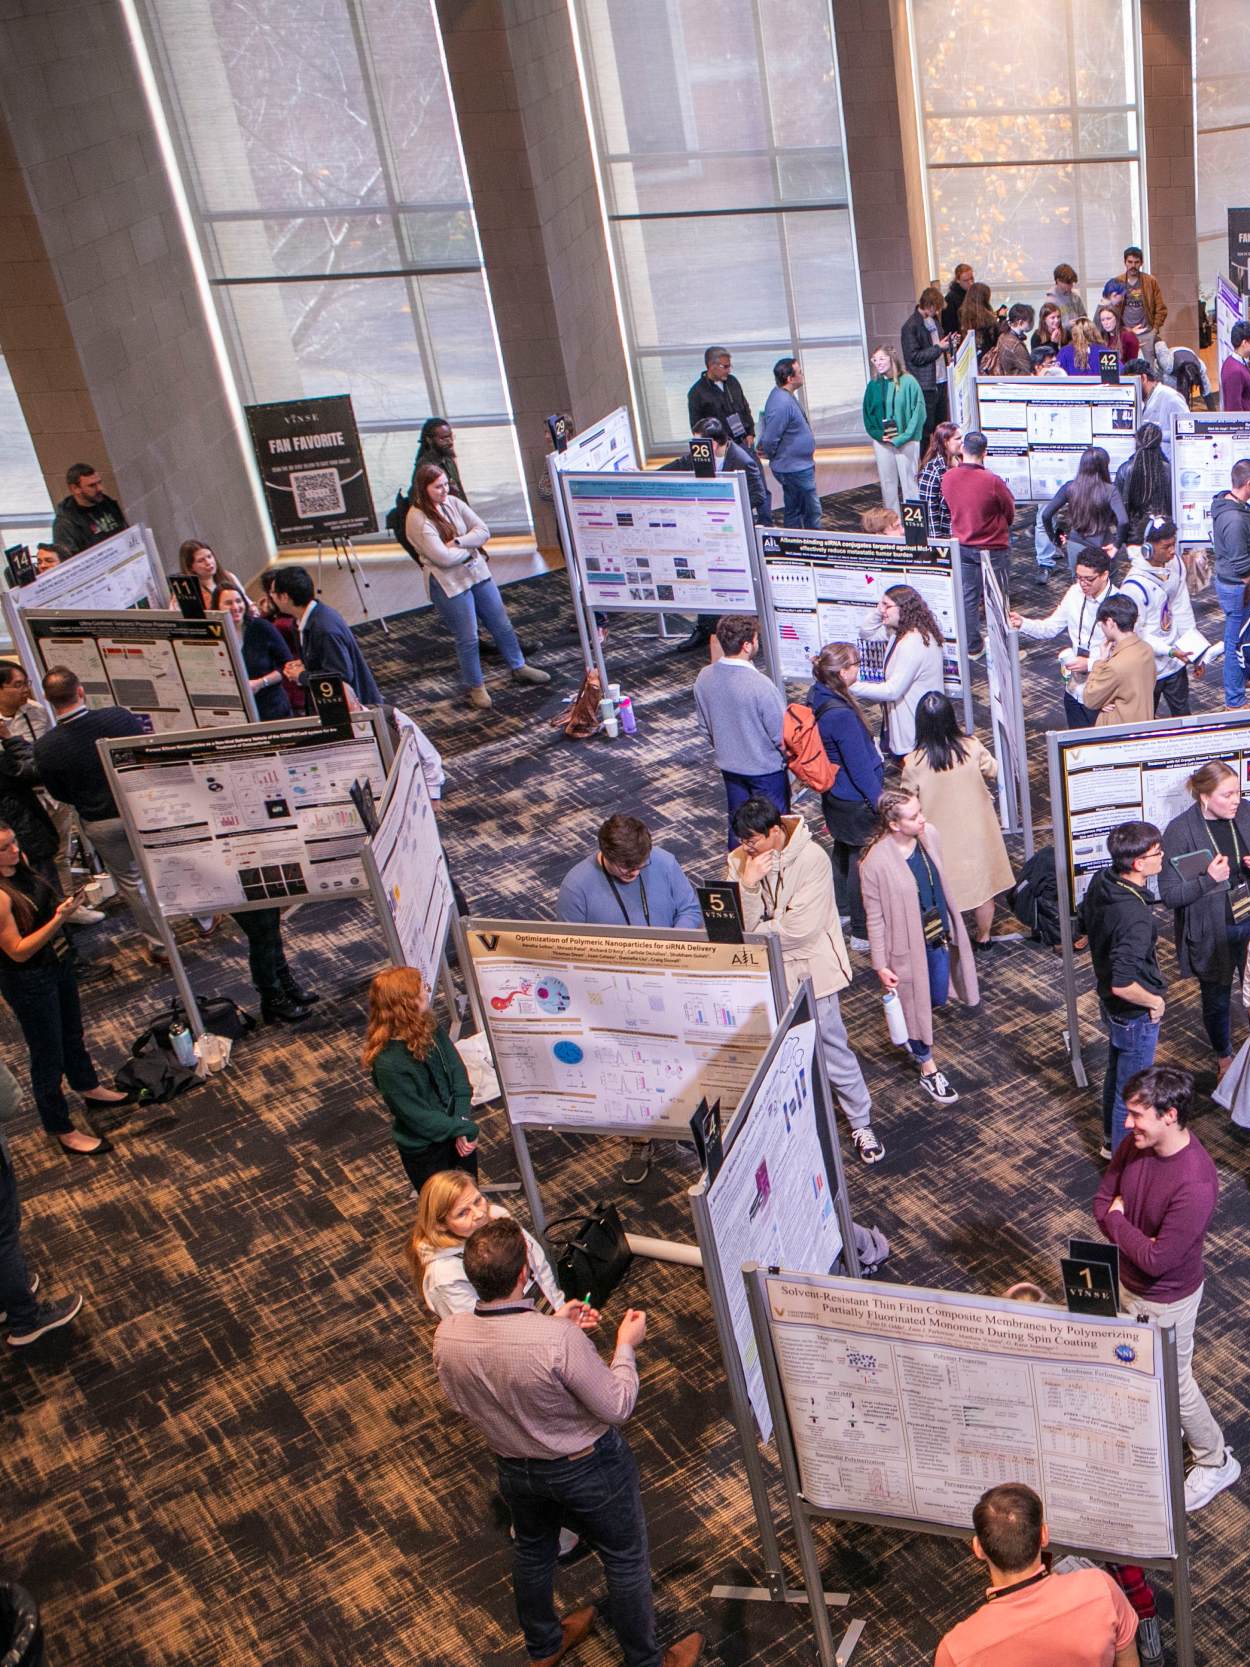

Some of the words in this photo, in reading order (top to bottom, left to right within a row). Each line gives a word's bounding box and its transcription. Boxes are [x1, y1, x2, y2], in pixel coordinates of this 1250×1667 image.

[1100, 354, 1117, 366] 42
[555, 419, 565, 434] 29
[268, 437, 292, 454] FAN
[293, 431, 345, 452] FAVORITE
[691, 444, 709, 458] 26
[903, 507, 923, 522] 24
[781, 537, 824, 547] Albumin-binding
[842, 542, 871, 550] conjugates
[936, 547, 949, 558] V
[13, 555, 28, 570] 14
[172, 579, 192, 595] 11
[208, 625, 221, 636] V
[320, 682, 334, 698] 9
[709, 894, 724, 911] 5
[476, 934, 500, 952] V
[515, 934, 560, 944] Optimization
[569, 937, 603, 948] Polymeric
[605, 940, 653, 950] Nanoparticles
[665, 943, 686, 951] siRNA
[687, 944, 717, 953] Delivery
[1079, 1267, 1093, 1289] 1
[1070, 1288, 1110, 1300] VINSE
[781, 1285, 869, 1307] Solvent-Resistant
[872, 1298, 896, 1311] Thin
[899, 1302, 924, 1314] Film
[926, 1306, 982, 1324] Composite
[985, 1314, 1047, 1331] Membranes
[1049, 1323, 1064, 1336] by
[1067, 1327, 1140, 1342] Polymerizing
[822, 1303, 864, 1320] Partially
[867, 1310, 926, 1326] Fluorinated
[929, 1318, 985, 1334] Monomers
[987, 1326, 1025, 1342] During
[1027, 1332, 1052, 1346] Spin
[1054, 1337, 1098, 1350] Coating
